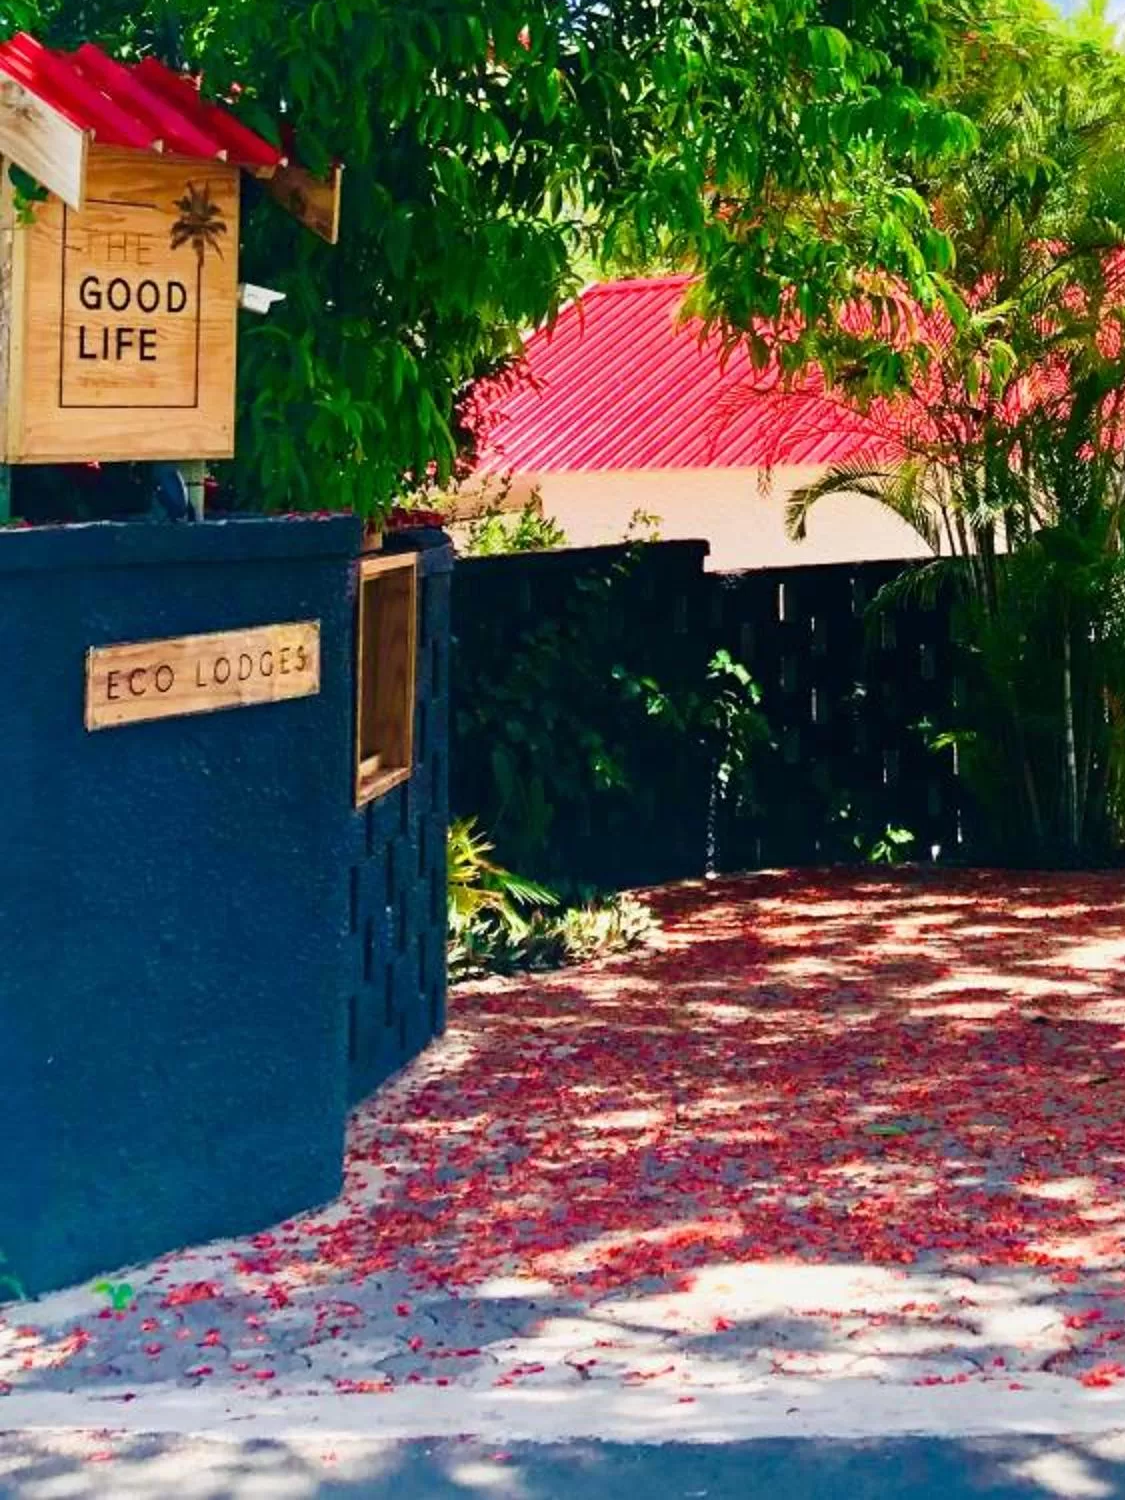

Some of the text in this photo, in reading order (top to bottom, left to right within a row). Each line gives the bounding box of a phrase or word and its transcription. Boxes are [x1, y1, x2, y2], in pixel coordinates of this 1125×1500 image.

[79, 276, 187, 312] GOOD
[79, 326, 156, 361] LIFE
[106, 645, 306, 700] ECO LODGES
